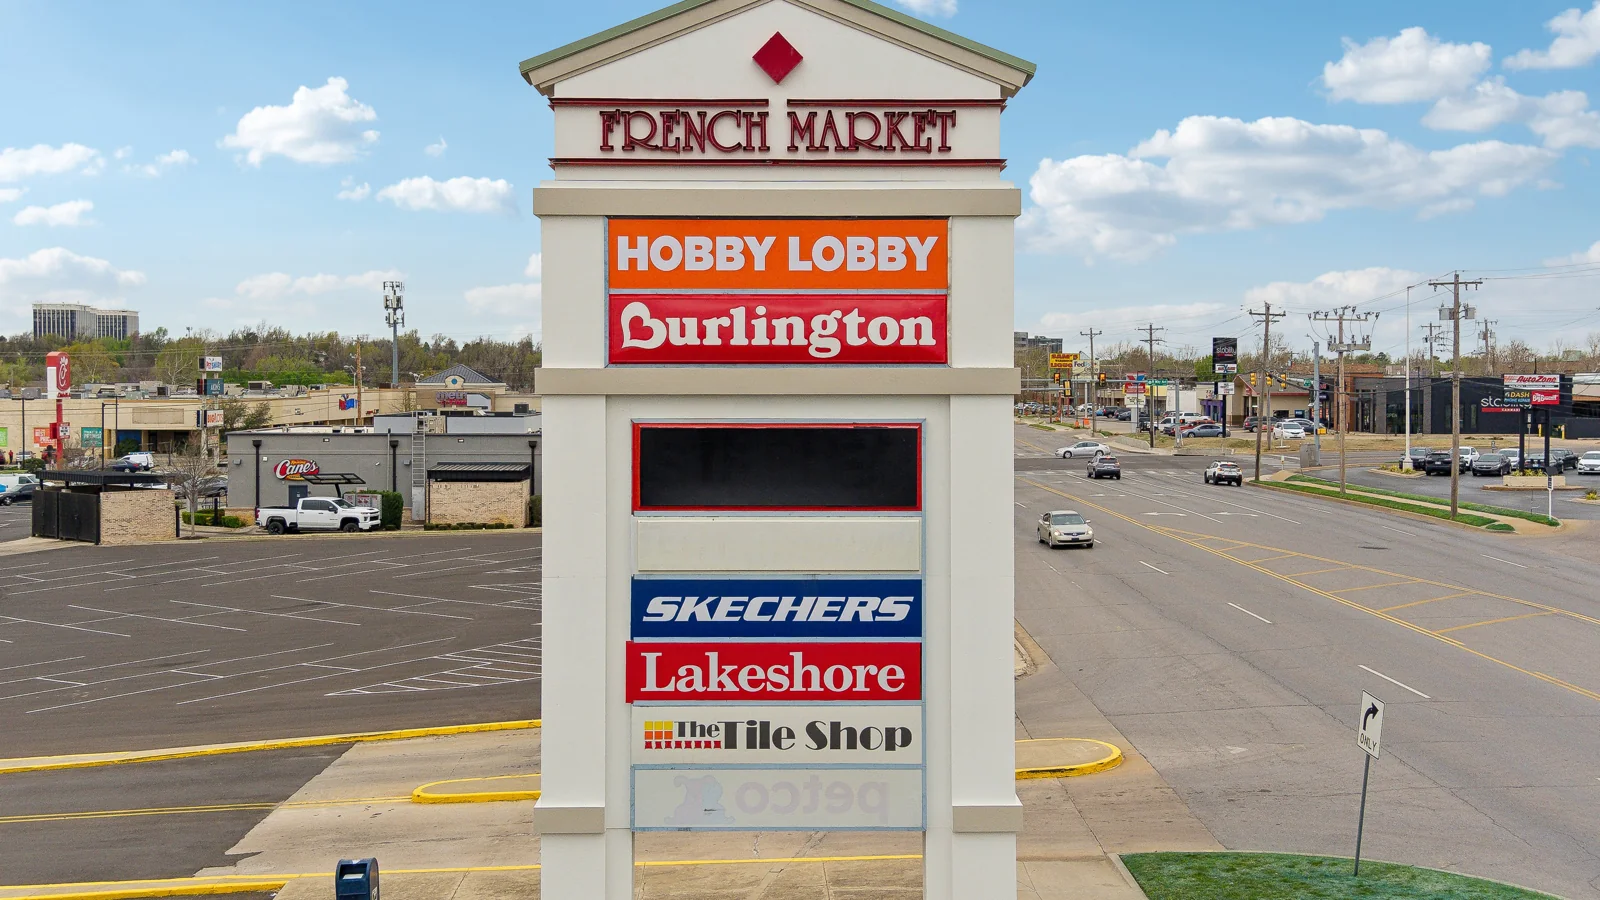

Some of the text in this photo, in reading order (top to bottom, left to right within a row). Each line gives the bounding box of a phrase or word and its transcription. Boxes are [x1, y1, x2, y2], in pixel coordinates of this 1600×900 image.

[599, 109, 957, 153] FRENCH MARKET
[617, 235, 938, 271] HOBBY LOBBY
[620, 301, 936, 358] Burlington
[1516, 375, 1557, 383] AutoZone
[276, 459, 319, 479] Cane's
[642, 596, 914, 622] SKECHERS
[640, 652, 905, 693] Lakeshore
[674, 720, 912, 751] The Tile Shop
[1360, 733, 1377, 752] ONLY
